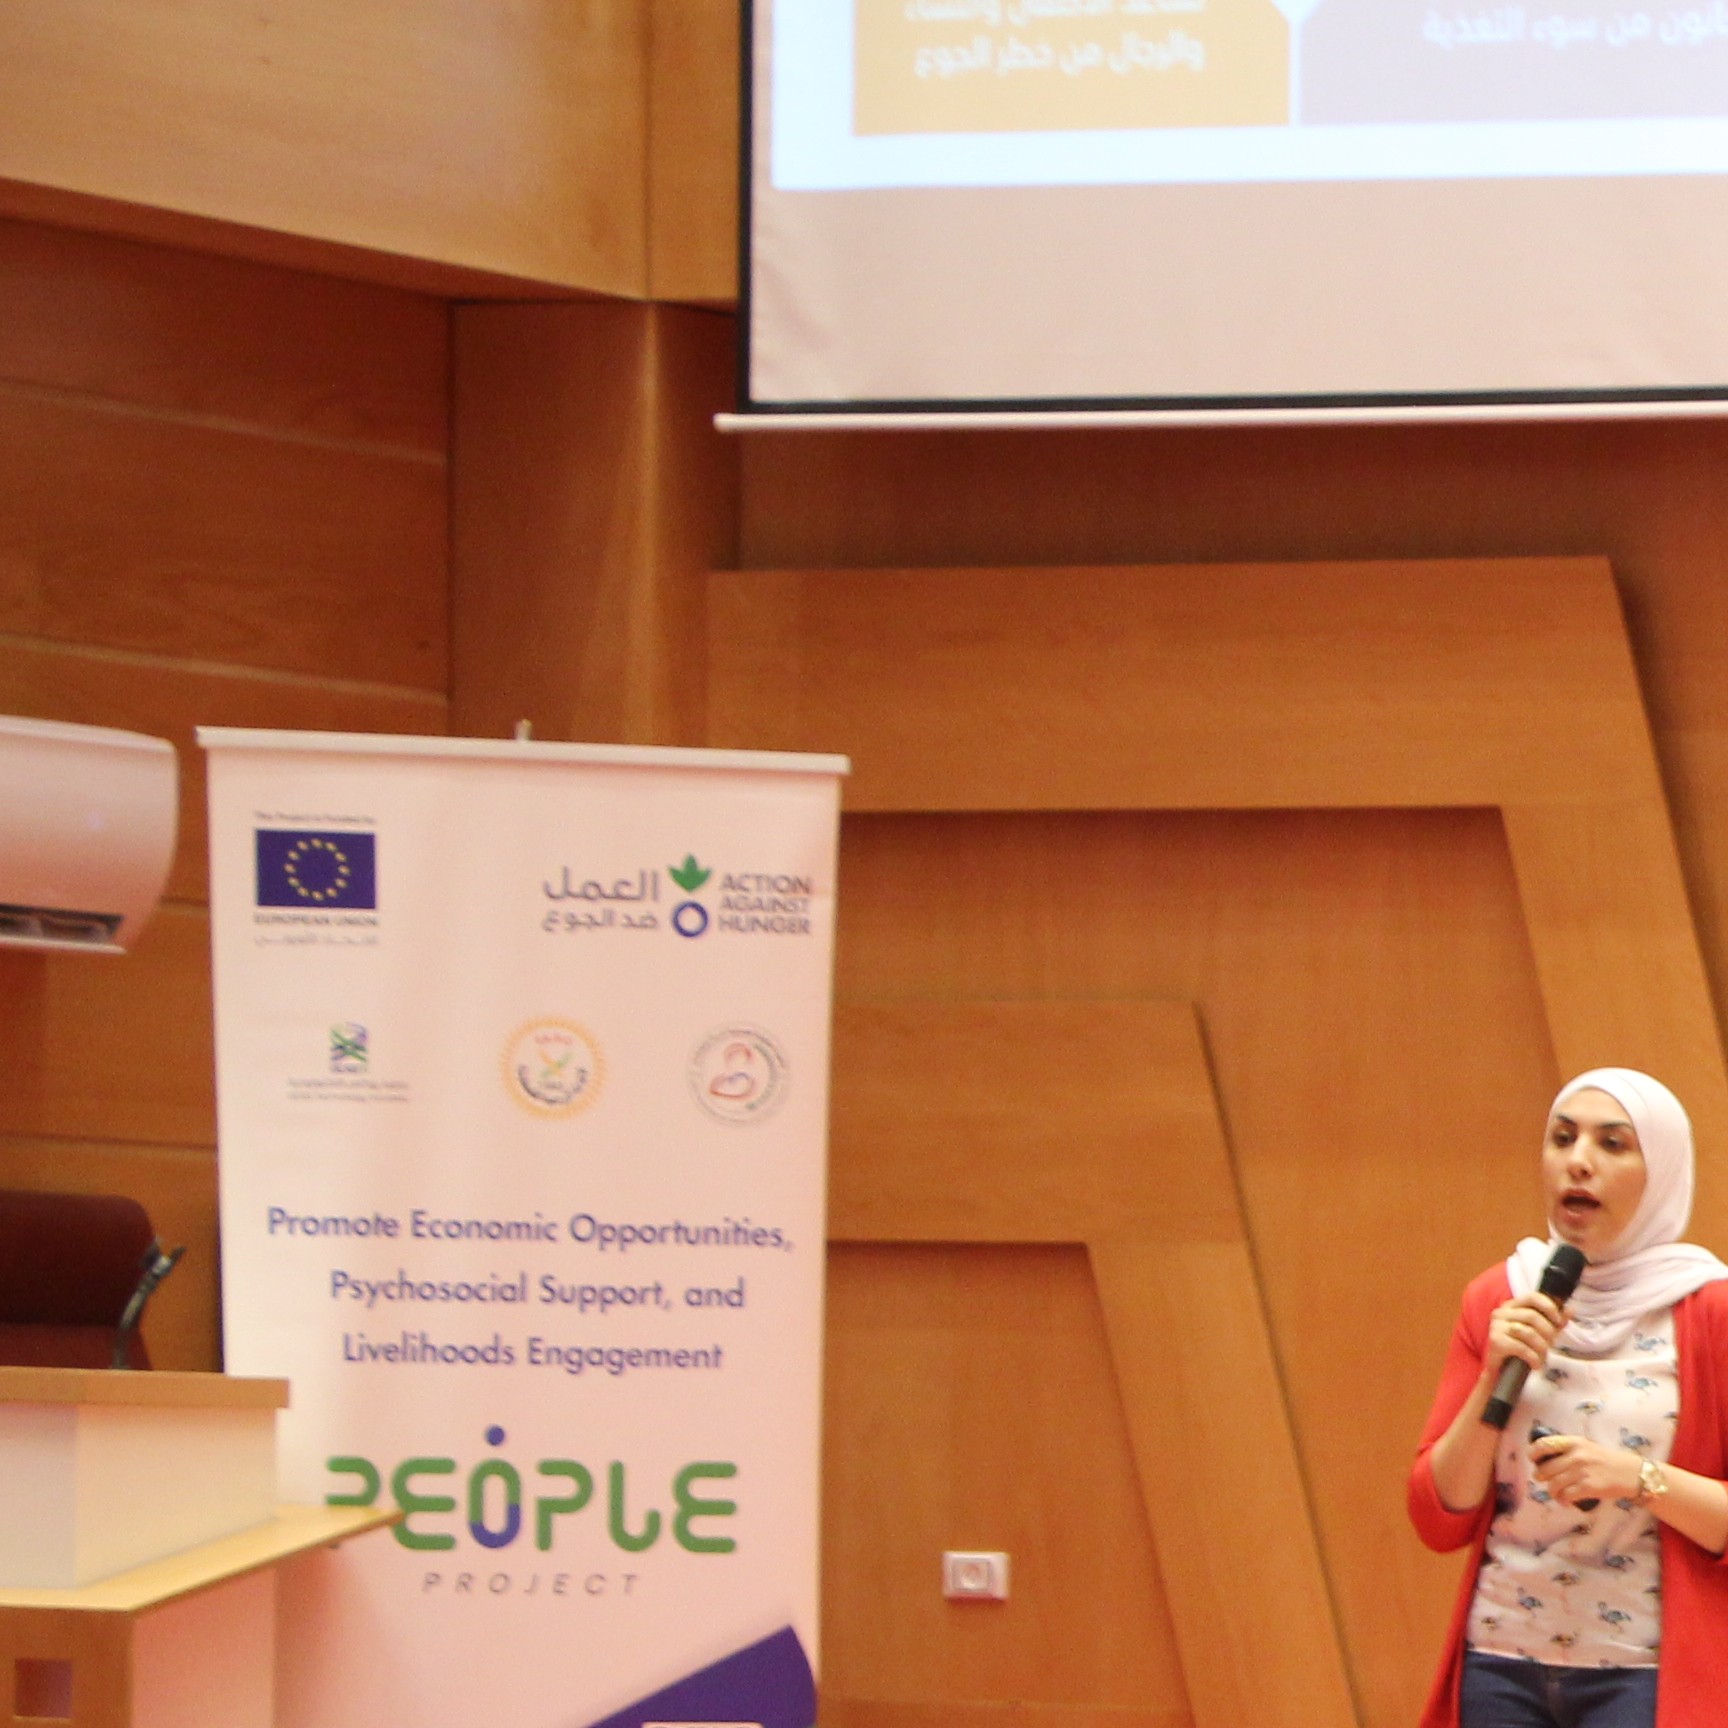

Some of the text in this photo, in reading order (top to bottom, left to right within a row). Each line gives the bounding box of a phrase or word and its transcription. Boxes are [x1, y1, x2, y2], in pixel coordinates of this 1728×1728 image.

[543, 866, 659, 902] العمل
[720, 873, 811, 895] ACTION
[720, 895, 809, 913] AGAINST
[542, 908, 659, 933] ضد الجوع
[719, 914, 811, 935] HUNGER
[267, 1205, 794, 1251] Promote Economic Opportunities,
[329, 1268, 744, 1312] Psychosocial Support, and
[342, 1331, 723, 1376] Livelihoods Engagement
[421, 1571, 639, 1597] PROJECT
